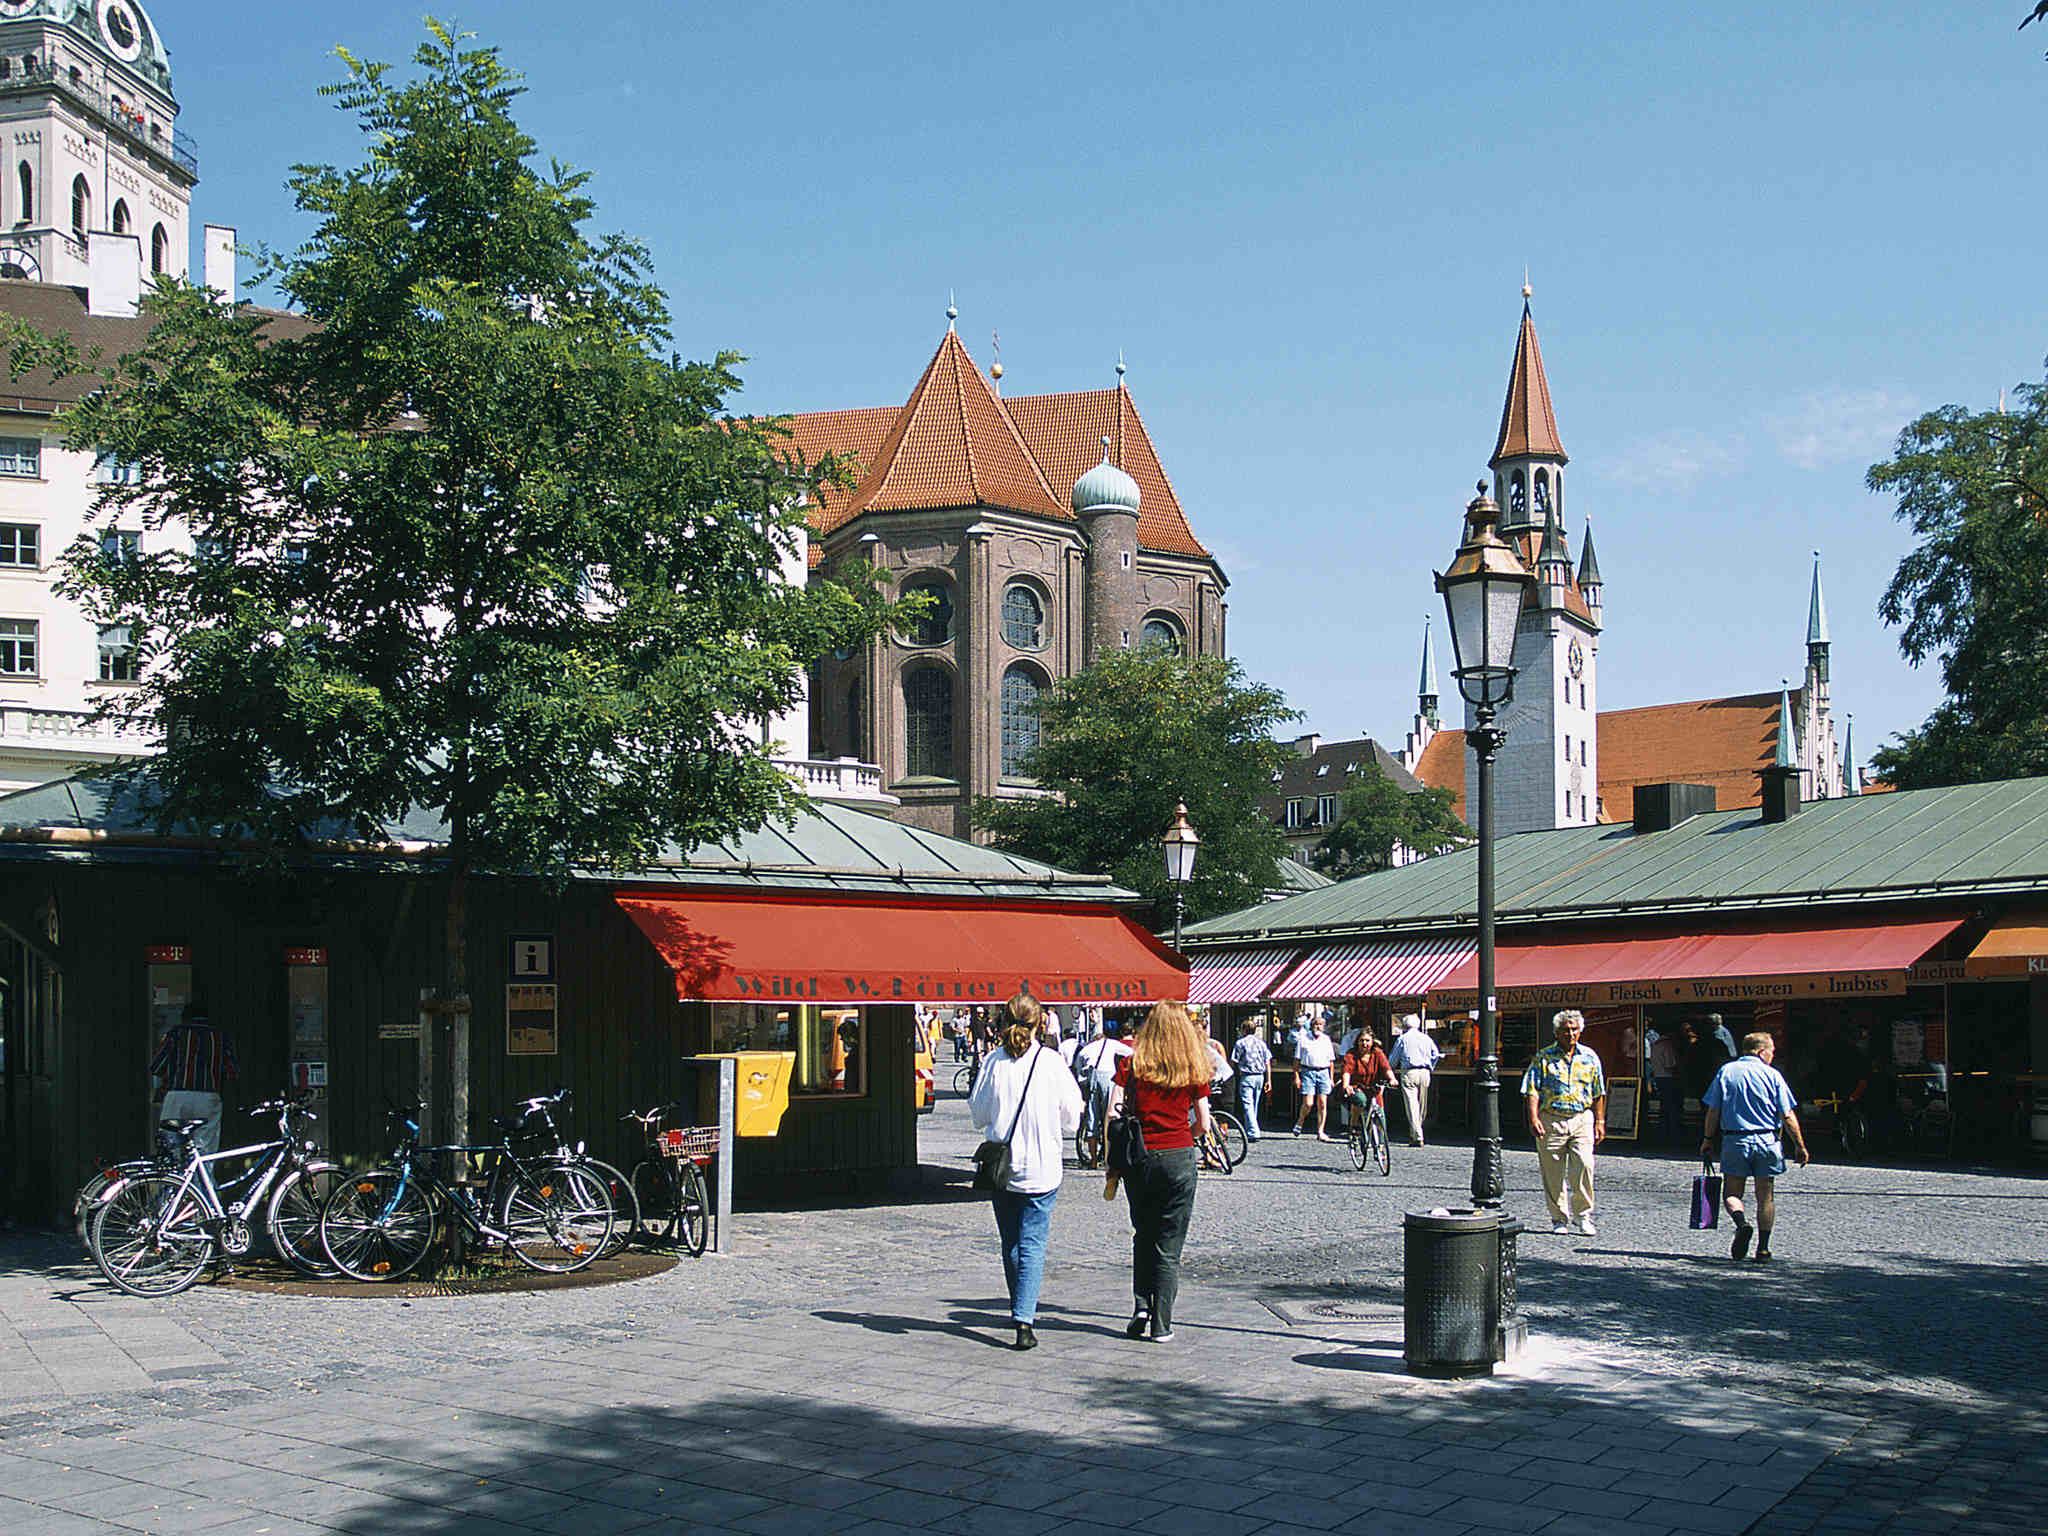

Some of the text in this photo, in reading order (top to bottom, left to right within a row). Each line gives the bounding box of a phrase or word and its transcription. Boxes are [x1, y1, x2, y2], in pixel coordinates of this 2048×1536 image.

[734, 976, 817, 996] Wild
[1608, 975, 1889, 1000] Fleisch Wurstwaren Imbiss
[1436, 987, 1590, 1008] Metzge EISENREICH
